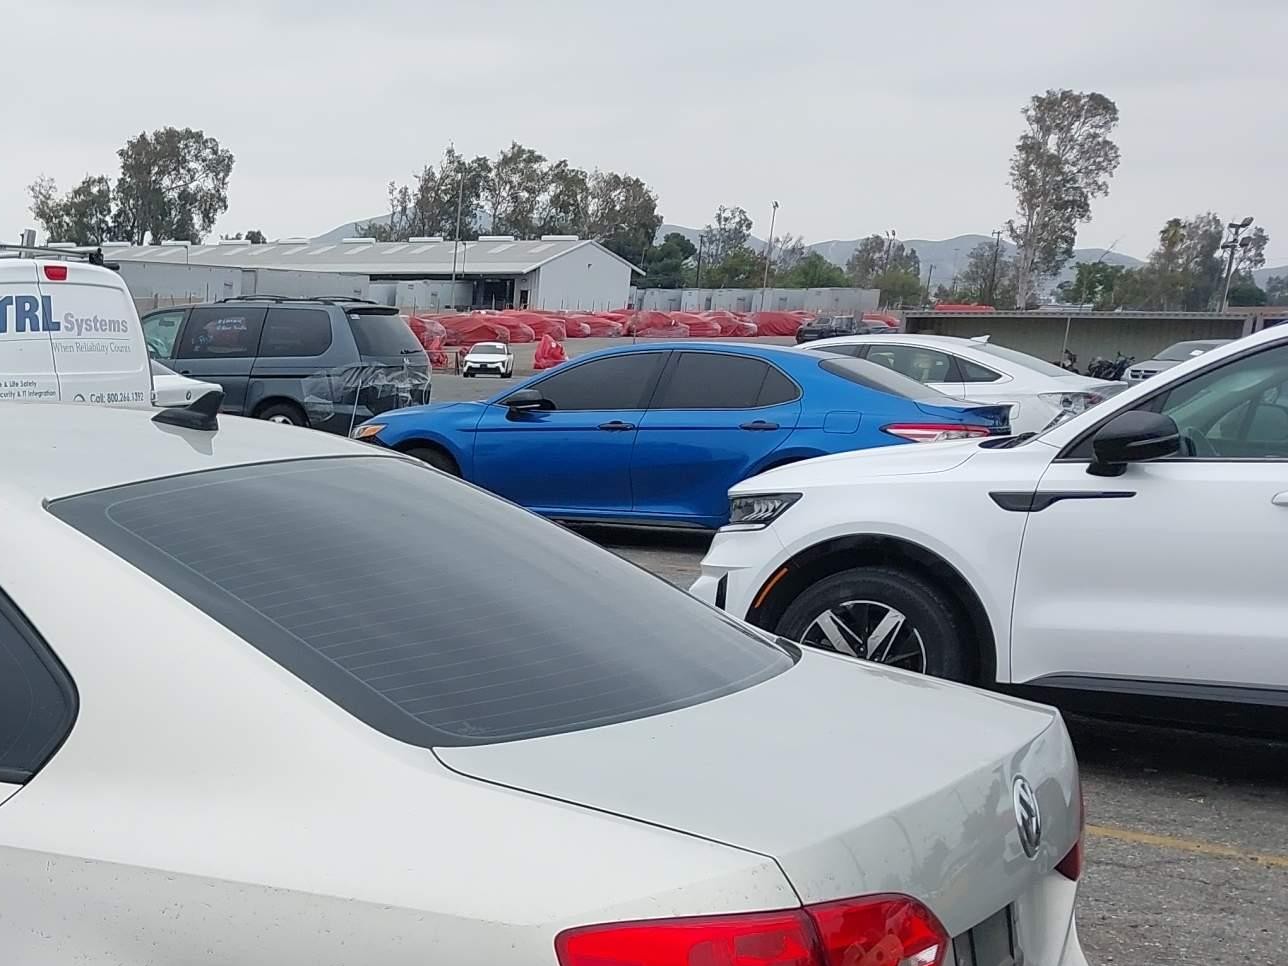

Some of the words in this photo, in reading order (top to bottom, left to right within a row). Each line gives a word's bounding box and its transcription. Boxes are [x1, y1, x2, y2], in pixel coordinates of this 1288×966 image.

[63, 312, 129, 336] Systems
[53, 342, 75, 352] When
[75, 342, 109, 355] Reliability
[110, 343, 131, 353] Counts
[20, 380, 37, 388] Safety
[28, 390, 57, 398] Integration
